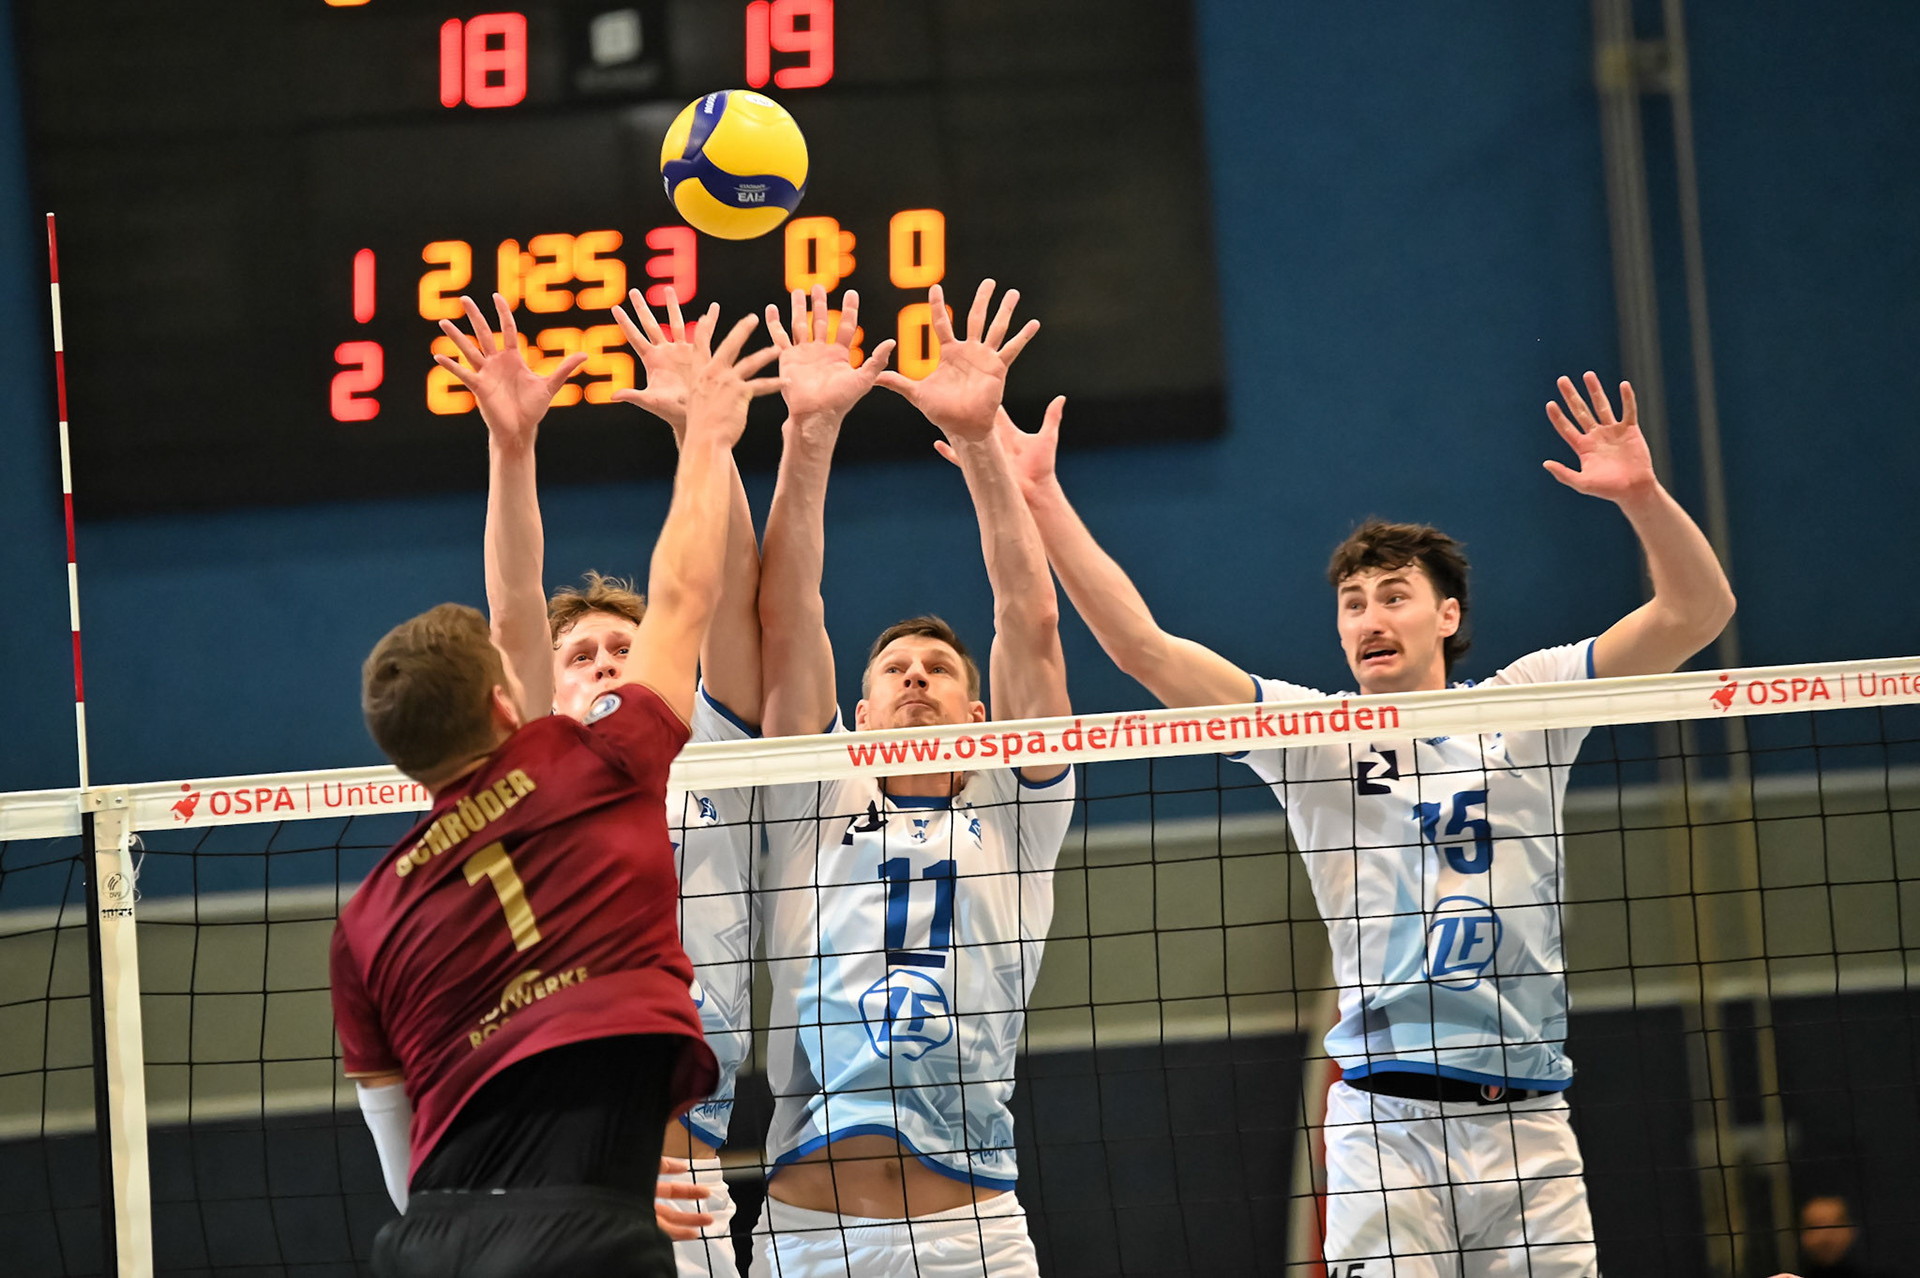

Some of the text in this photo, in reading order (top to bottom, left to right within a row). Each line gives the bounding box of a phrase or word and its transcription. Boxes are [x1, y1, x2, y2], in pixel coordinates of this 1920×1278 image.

[440, 12, 527, 108] 18
[745, 0, 834, 89] 19
[353, 248, 375, 323] 1
[645, 225, 697, 306] 3
[330, 340, 384, 422] 2
[847, 700, 1401, 766] www.ospa.de/firmenkunden
[1747, 676, 1831, 706] OSPA
[209, 786, 295, 816] OSPA
[877, 857, 957, 952] 11
